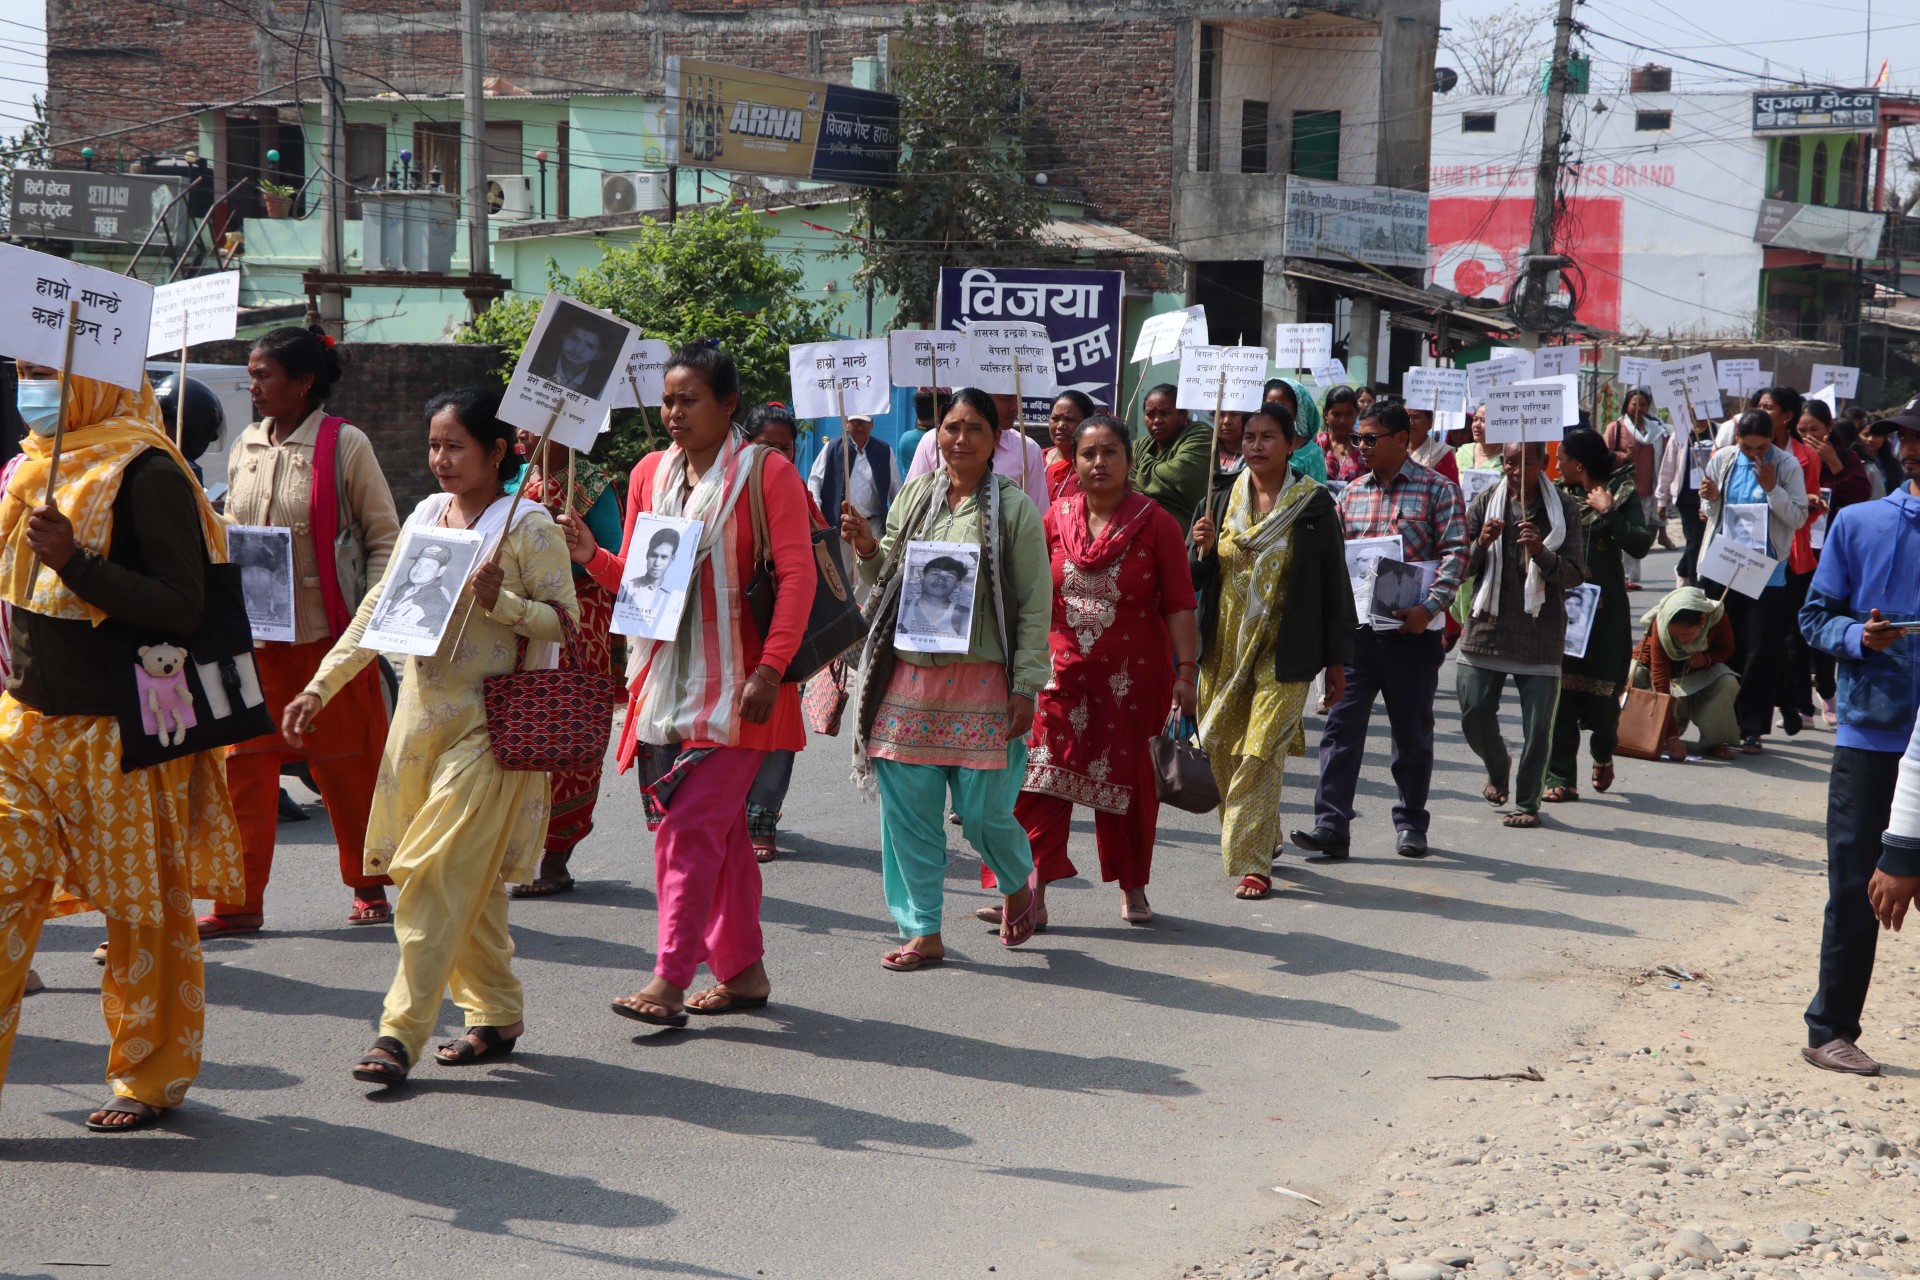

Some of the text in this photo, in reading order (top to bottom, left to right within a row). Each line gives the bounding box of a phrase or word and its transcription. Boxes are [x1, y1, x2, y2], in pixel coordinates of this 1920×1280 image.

[1757, 91, 1873, 112] सृजना होटल
[728, 99, 804, 142] ARNA
[825, 113, 853, 138] विजया
[854, 114, 870, 140] गेष्ट
[639, 176, 650, 184] CG
[1612, 164, 1675, 187] BRAND
[24, 178, 71, 197] सिटी होटल
[19, 203, 37, 216] एण्ड
[94, 220, 118, 234] TIGER
[36, 277, 122, 314] हाम्रो मान्छे
[959, 268, 1104, 319] विजया
[74, 319, 102, 345] छन्
[114, 327, 122, 344] ?
[914, 340, 957, 352] हाम्रो मान्छे
[1014, 344, 1044, 357] पारिएका
[1050, 323, 1112, 373] उस
[816, 352, 867, 370] हाम्रो मान्छे
[935, 357, 950, 369] छन्
[955, 357, 960, 367] ?
[1216, 351, 1225, 360] १०
[527, 374, 539, 386] मेरो
[543, 381, 563, 395] श्रीमान
[583, 398, 589, 406] ?
[841, 377, 861, 391] छन्
[866, 375, 872, 388] ?
[1230, 392, 1239, 400] गर
[1522, 402, 1550, 412] पारिएका
